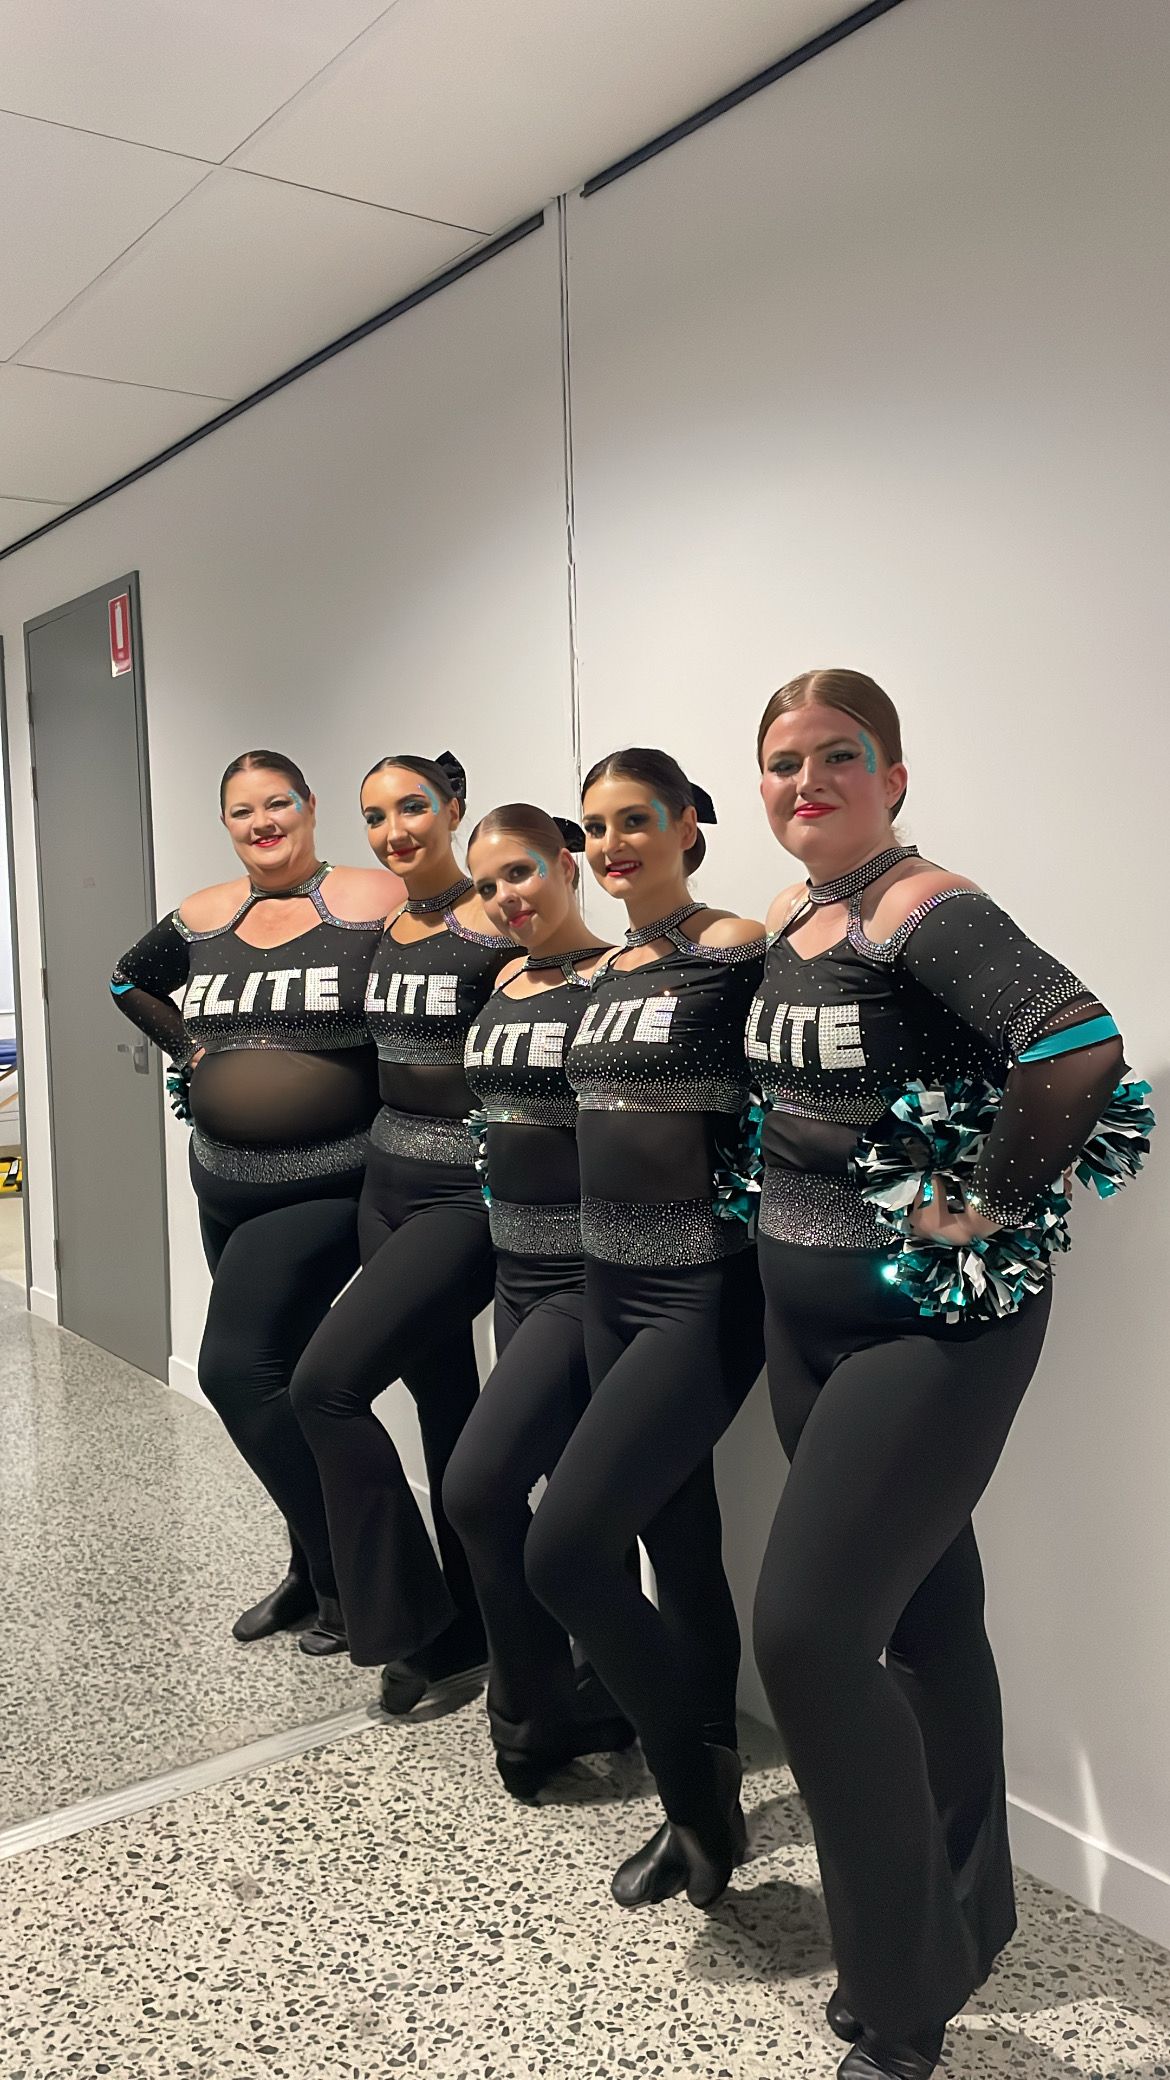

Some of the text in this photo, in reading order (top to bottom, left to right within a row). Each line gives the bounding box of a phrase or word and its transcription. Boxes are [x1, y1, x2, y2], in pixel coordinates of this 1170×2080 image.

[183, 966, 340, 1019] ELITE
[364, 973, 458, 1015] LITE
[464, 1023, 568, 1068] LITE
[571, 997, 678, 1049] LITE
[744, 997, 867, 1070] LITE
